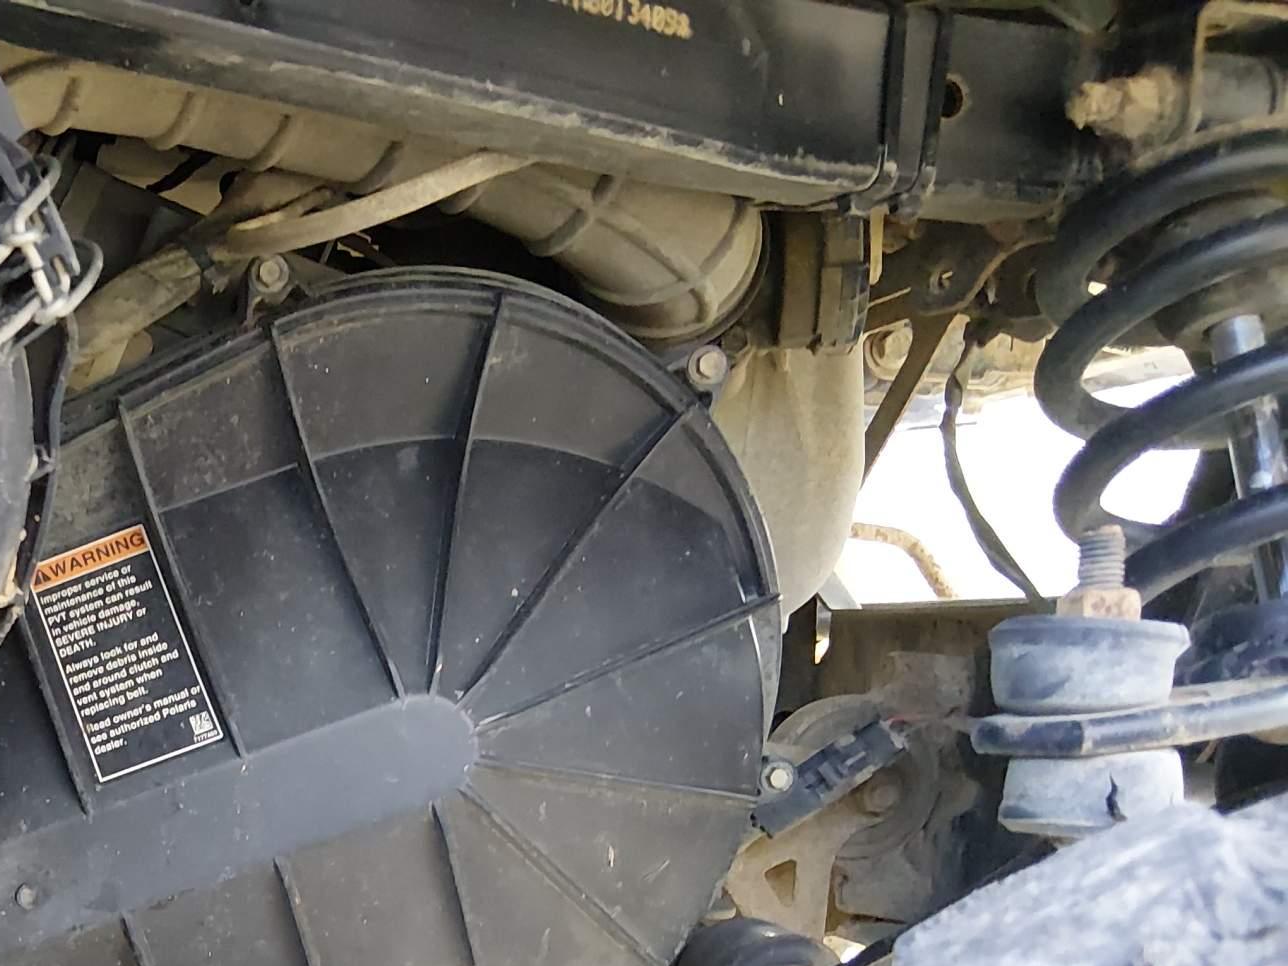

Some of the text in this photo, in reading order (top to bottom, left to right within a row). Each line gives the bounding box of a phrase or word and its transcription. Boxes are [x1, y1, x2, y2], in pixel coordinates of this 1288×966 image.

[49, 532, 144, 577] WARNING
[40, 565, 132, 605] Improper service or
[44, 575, 136, 616] maintenance of this
[48, 580, 153, 627] PVT system can result
[52, 627, 62, 636] in
[63, 613, 97, 632] vehicle
[55, 607, 147, 647] SEVERE INJURY or
[59, 641, 96, 657] DEATH.
[65, 632, 159, 674] Always look for and
[69, 642, 168, 685] remove debris inside
[73, 649, 179, 696] and around clutch and
[77, 668, 162, 706] vent system when
[81, 686, 148, 717] replacing belt.
[86, 685, 201, 733] Read owner's manual or
[90, 699, 197, 745] see authorized Polaris
[95, 738, 127, 755] dealer.
